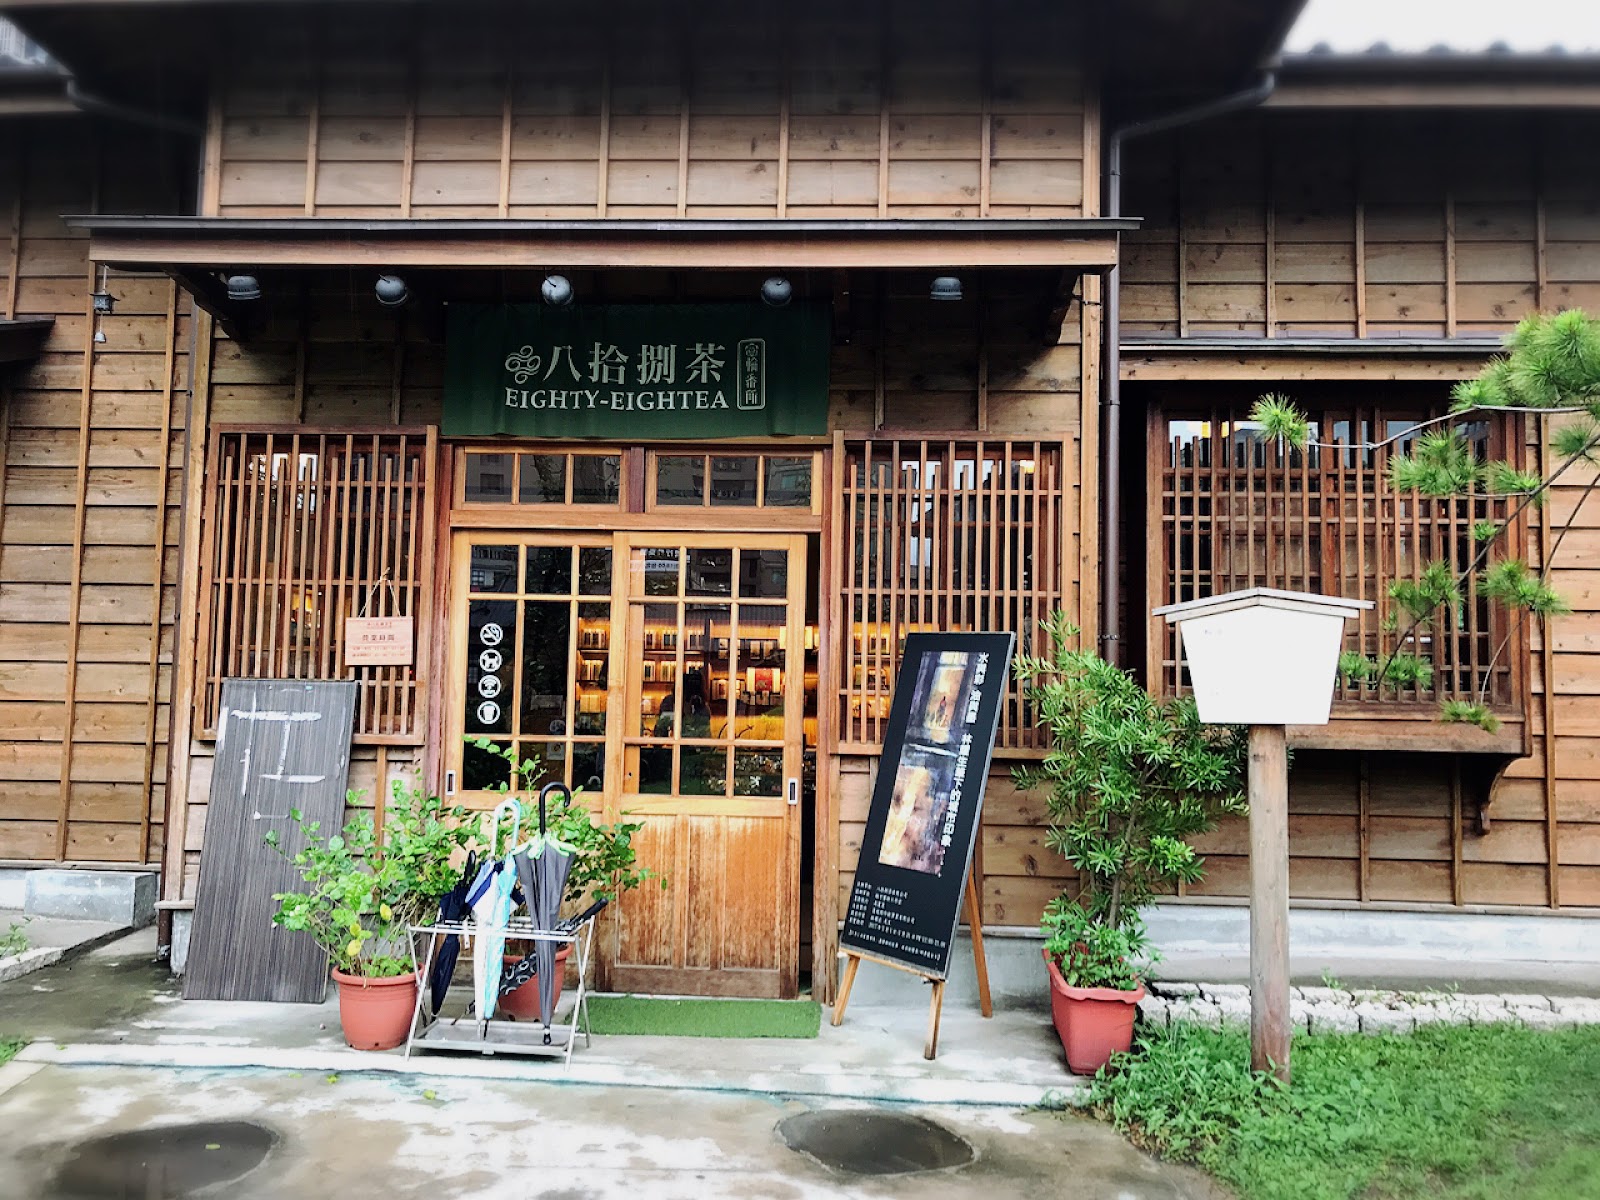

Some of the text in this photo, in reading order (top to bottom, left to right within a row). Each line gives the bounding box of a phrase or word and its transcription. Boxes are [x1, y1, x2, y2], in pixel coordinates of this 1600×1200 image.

[542, 342, 726, 385] 八拾捌茶
[505, 387, 730, 411] EIGHTY-EIGHTEA
